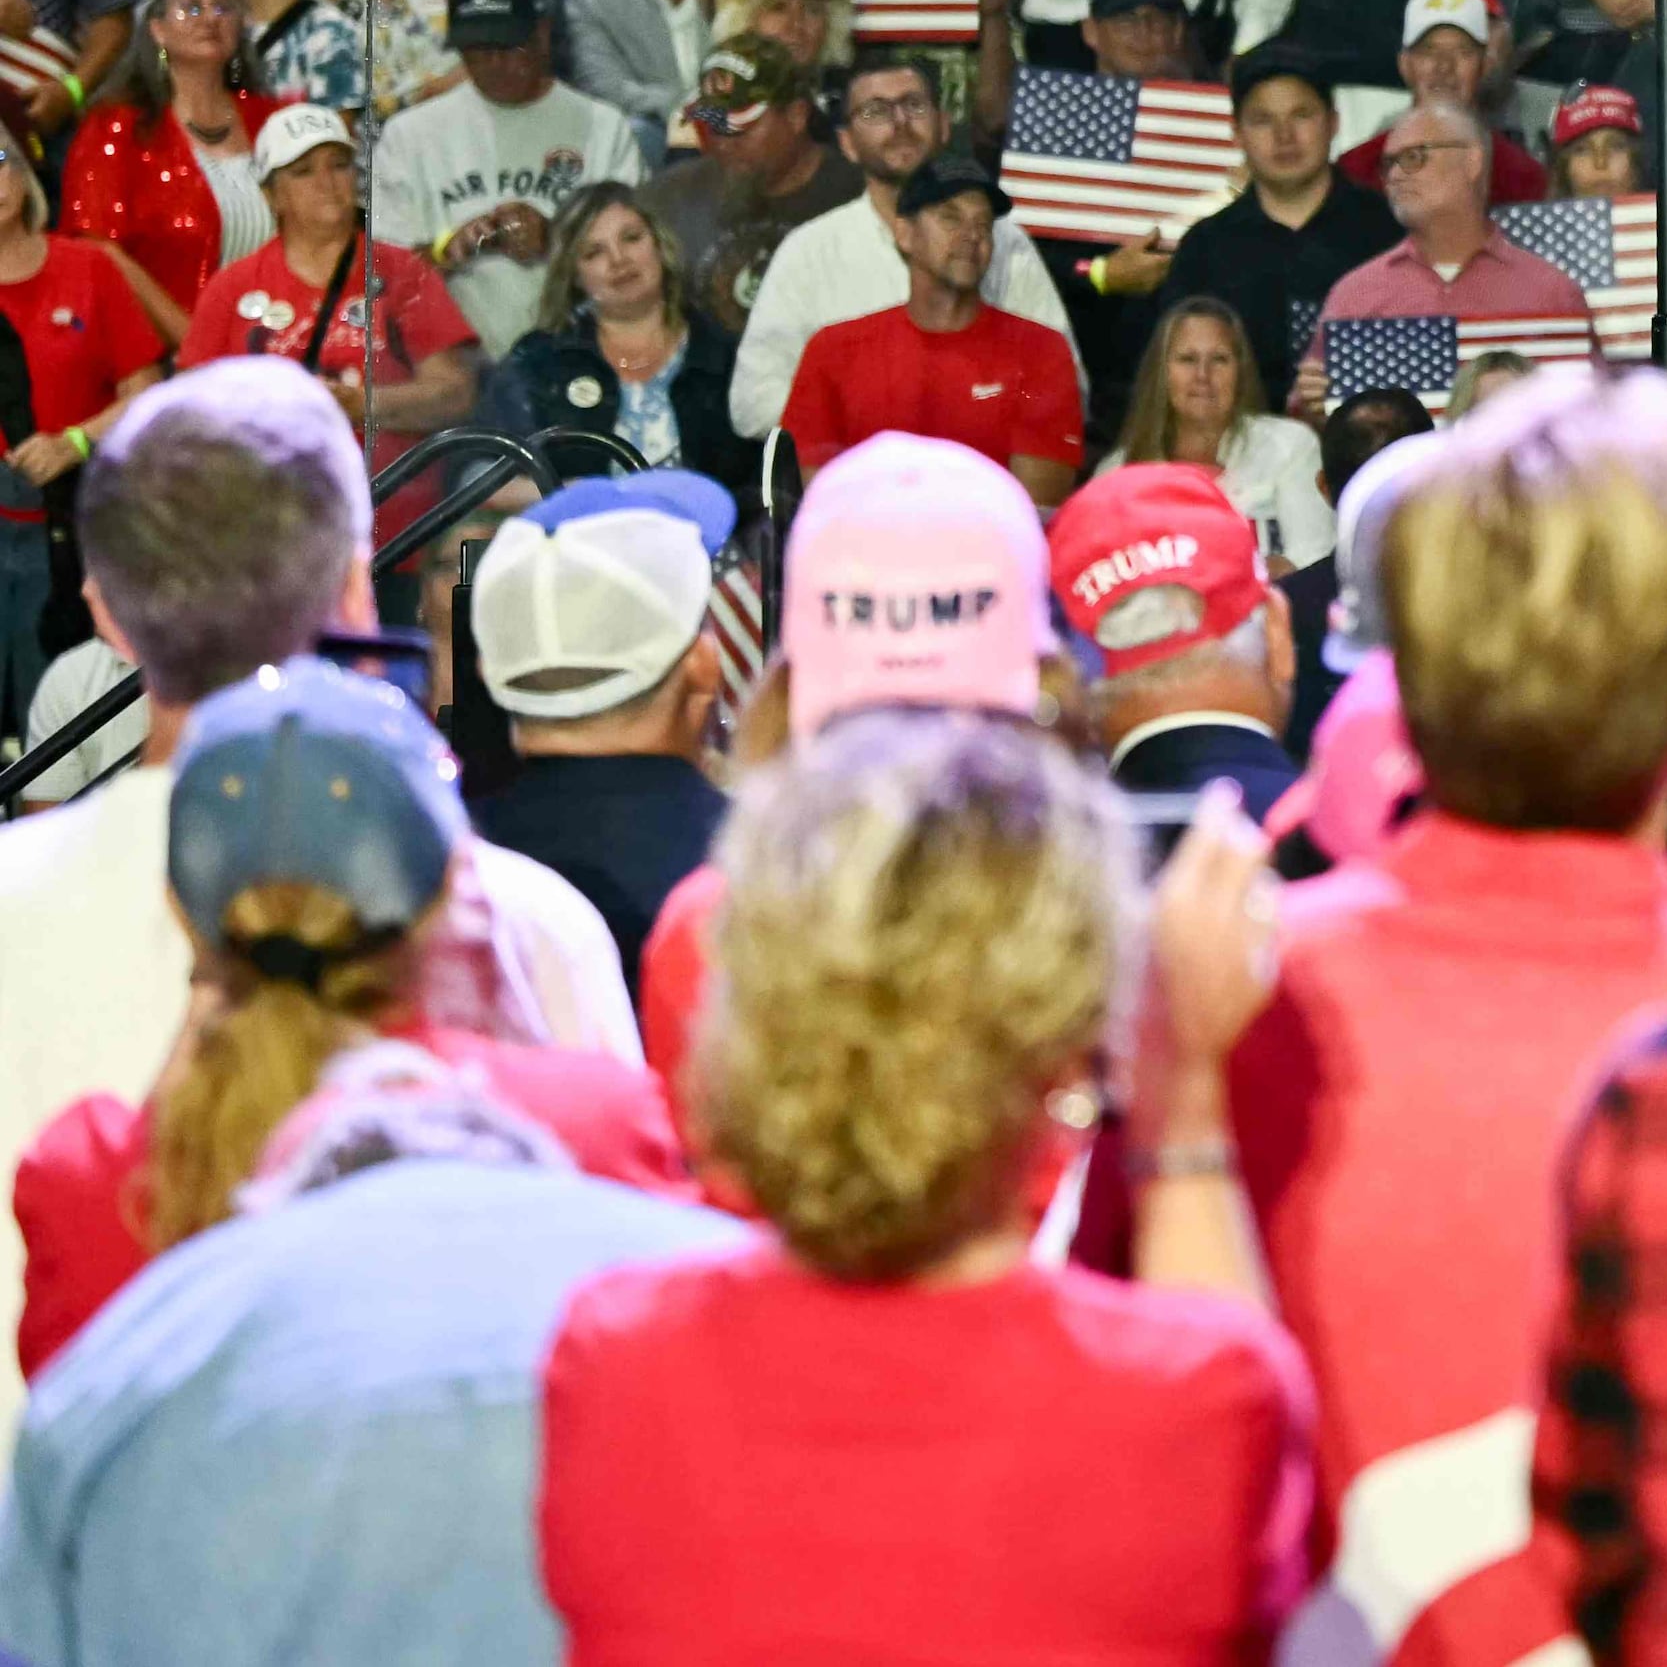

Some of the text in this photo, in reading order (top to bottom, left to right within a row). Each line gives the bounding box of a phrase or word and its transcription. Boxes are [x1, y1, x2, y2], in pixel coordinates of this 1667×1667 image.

[442, 169, 567, 206] AIR FORC
[1072, 534, 1198, 607] TRUMP
[822, 589, 998, 632] TRUMP
